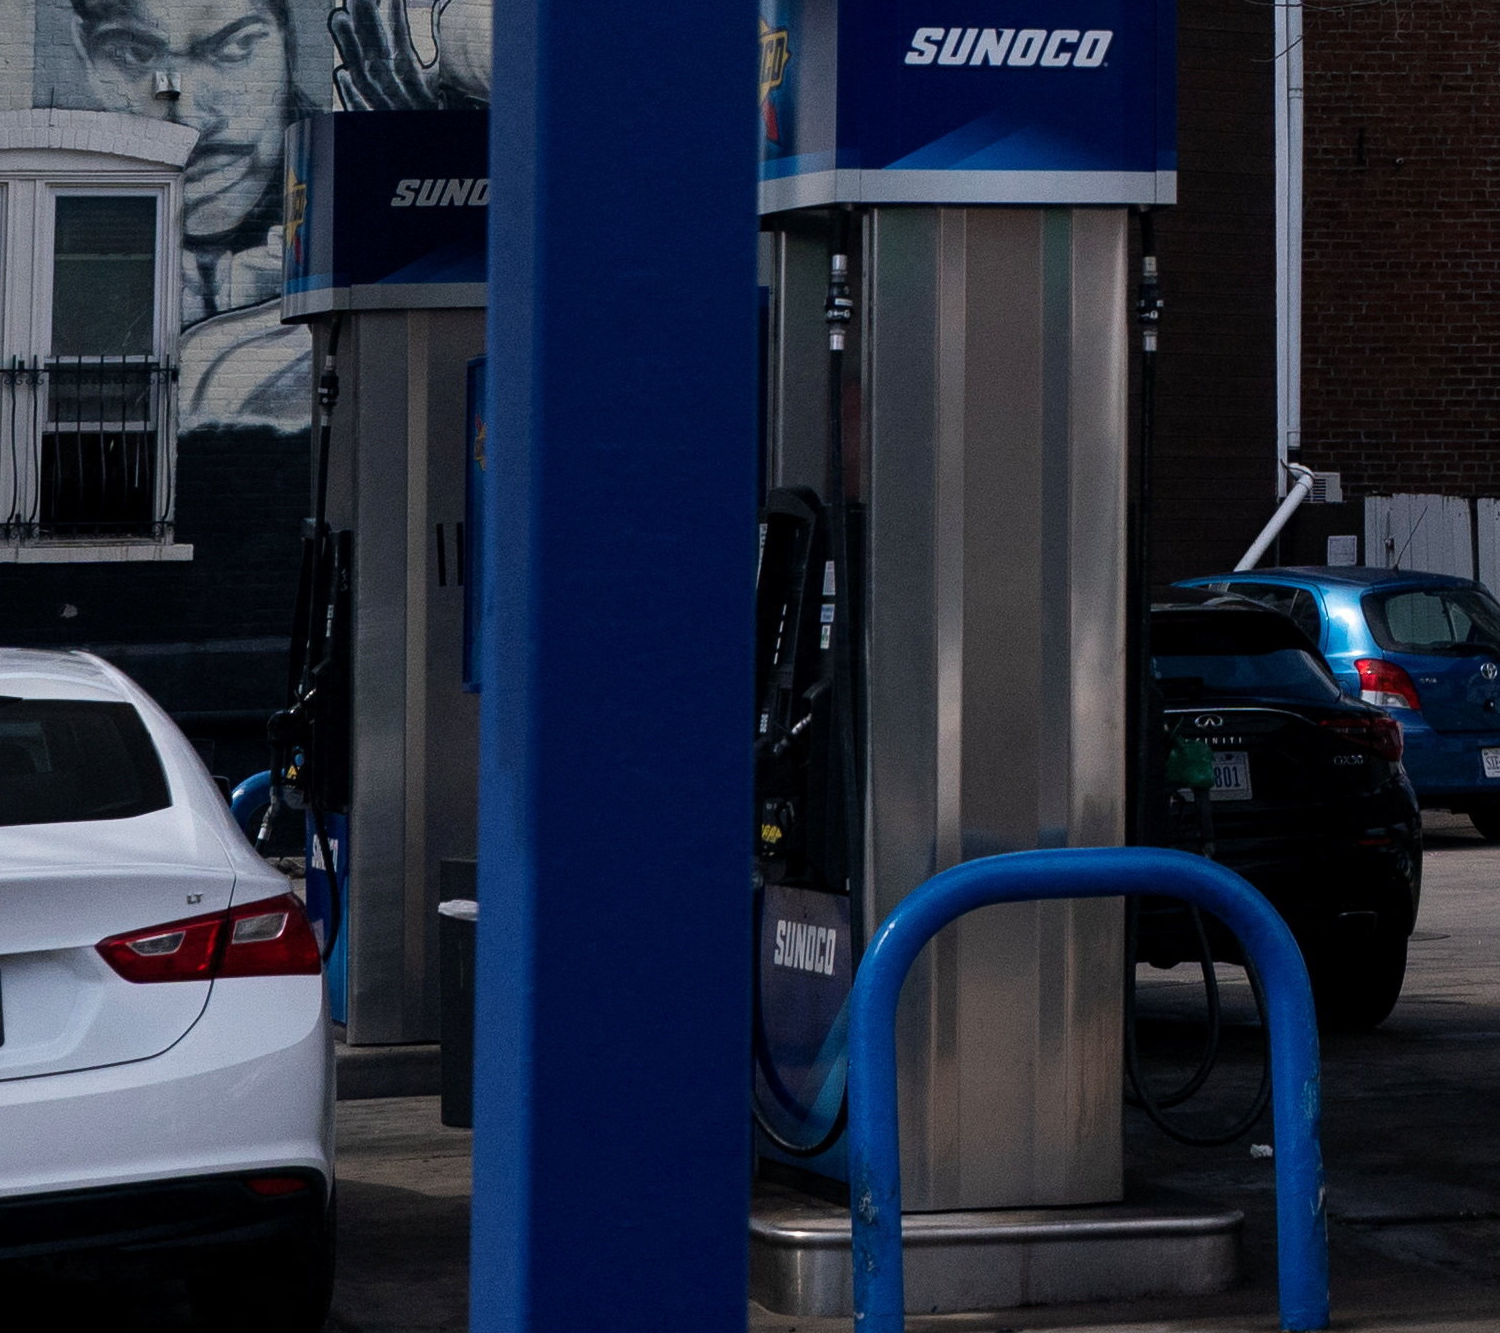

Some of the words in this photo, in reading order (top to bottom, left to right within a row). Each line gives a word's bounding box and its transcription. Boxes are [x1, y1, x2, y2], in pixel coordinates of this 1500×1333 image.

[904, 27, 1113, 67] SUNOCO
[391, 179, 490, 208] SUNO
[186, 892, 203, 905] LT
[774, 920, 837, 976] SUNOCO
